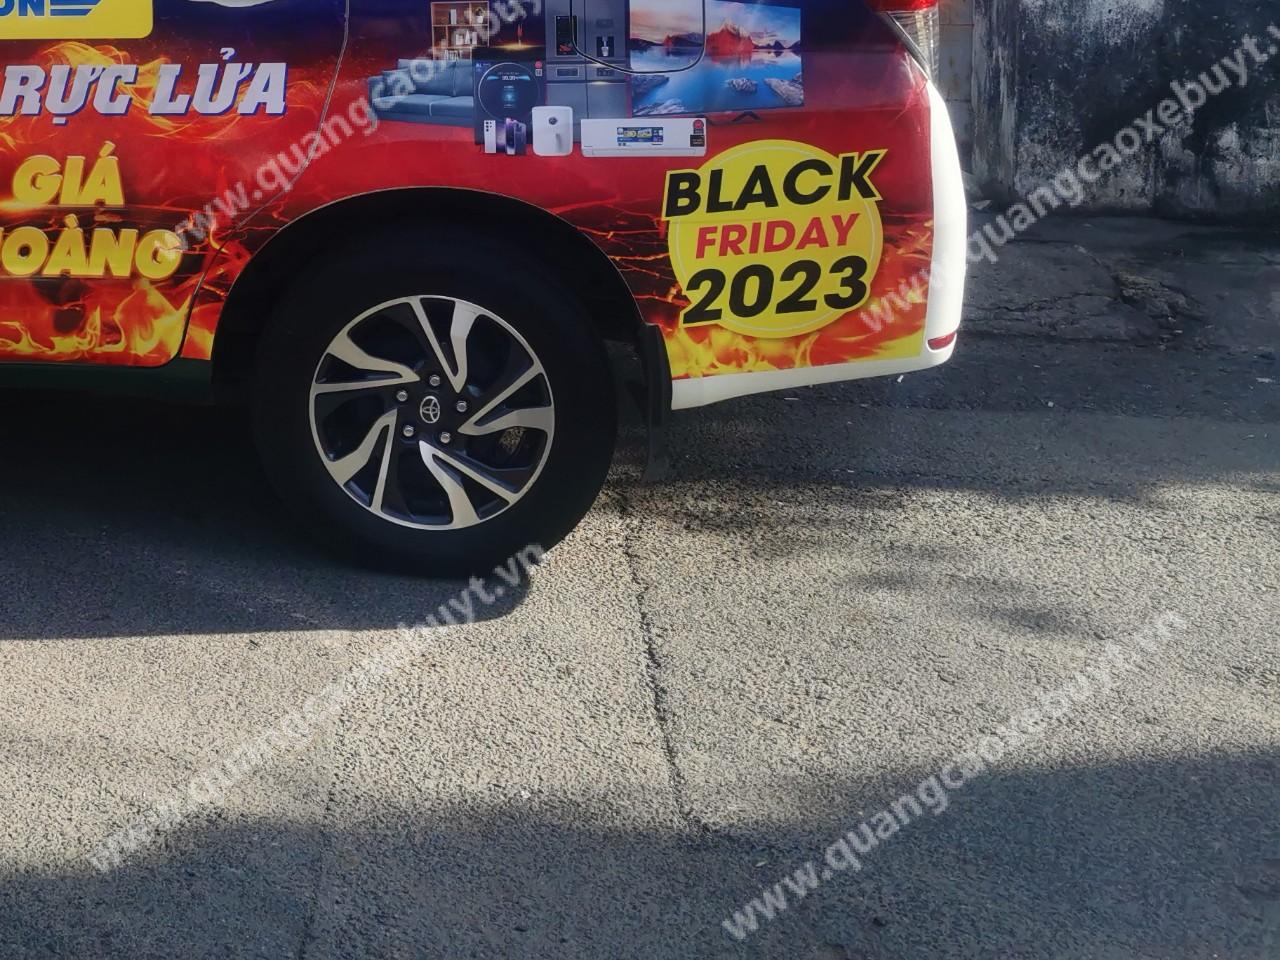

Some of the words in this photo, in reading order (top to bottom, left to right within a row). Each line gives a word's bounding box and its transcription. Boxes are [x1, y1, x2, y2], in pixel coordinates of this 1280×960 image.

[148, 47, 288, 118] LỬA
[11, 140, 126, 207] GIÁ
[664, 152, 882, 218] BLACK
[695, 212, 861, 259] FRIDAY
[682, 255, 868, 325] 2023
